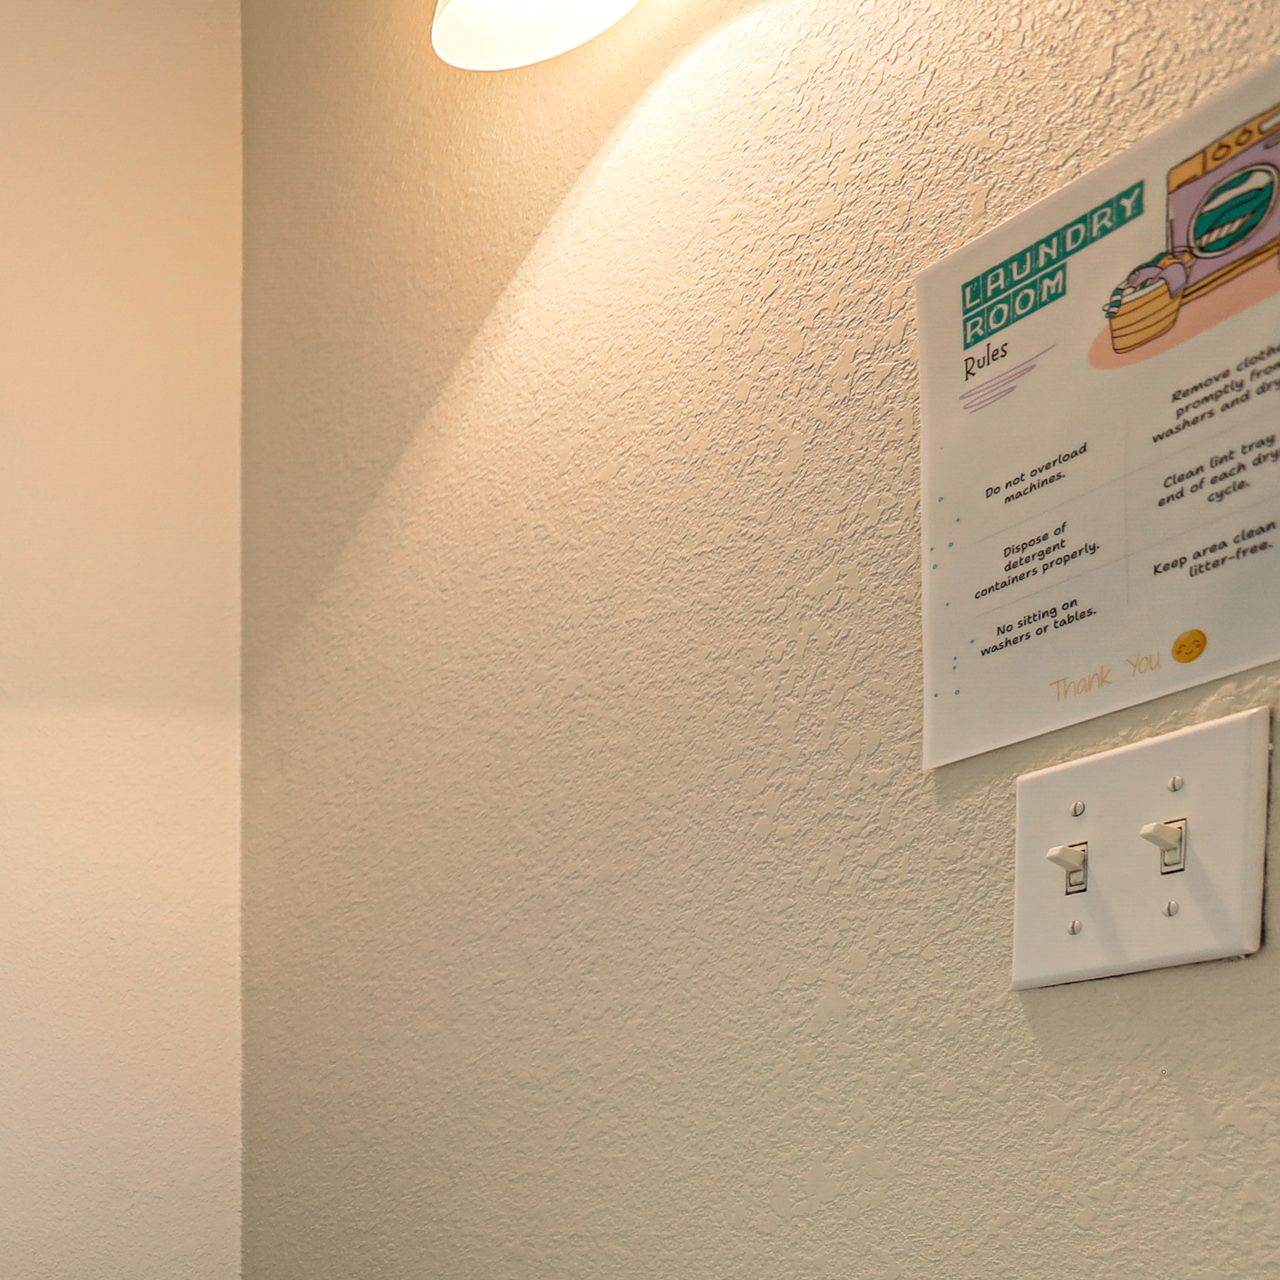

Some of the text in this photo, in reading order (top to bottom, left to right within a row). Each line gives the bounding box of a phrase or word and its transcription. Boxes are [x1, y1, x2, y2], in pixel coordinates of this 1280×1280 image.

[965, 188, 1141, 309] LAUNDRY
[966, 269, 1064, 344] ROOM
[964, 342, 1008, 381] Rules
[1171, 369, 1230, 403] Remove
[1176, 379, 1244, 420] promptly
[1152, 409, 1215, 443] washers
[1220, 389, 1251, 412] and
[985, 442, 1088, 498] Do not overload
[1163, 434, 1276, 488] Clean lint tray
[1004, 471, 1066, 504] machines.
[1158, 487, 1185, 507] end
[1190, 477, 1206, 493] of
[1210, 462, 1247, 485] each
[1207, 480, 1251, 502] cycle.
[1003, 521, 1067, 558] Dispose of
[1004, 539, 1066, 572] detergent
[1153, 521, 1277, 576] Keep area clean
[1189, 541, 1274, 577] litter-free.
[974, 543, 1100, 599] containers properly.
[980, 607, 1097, 656] washers or tables.
[996, 599, 1078, 636] No sitting on
[1049, 665, 1113, 702] Thank
